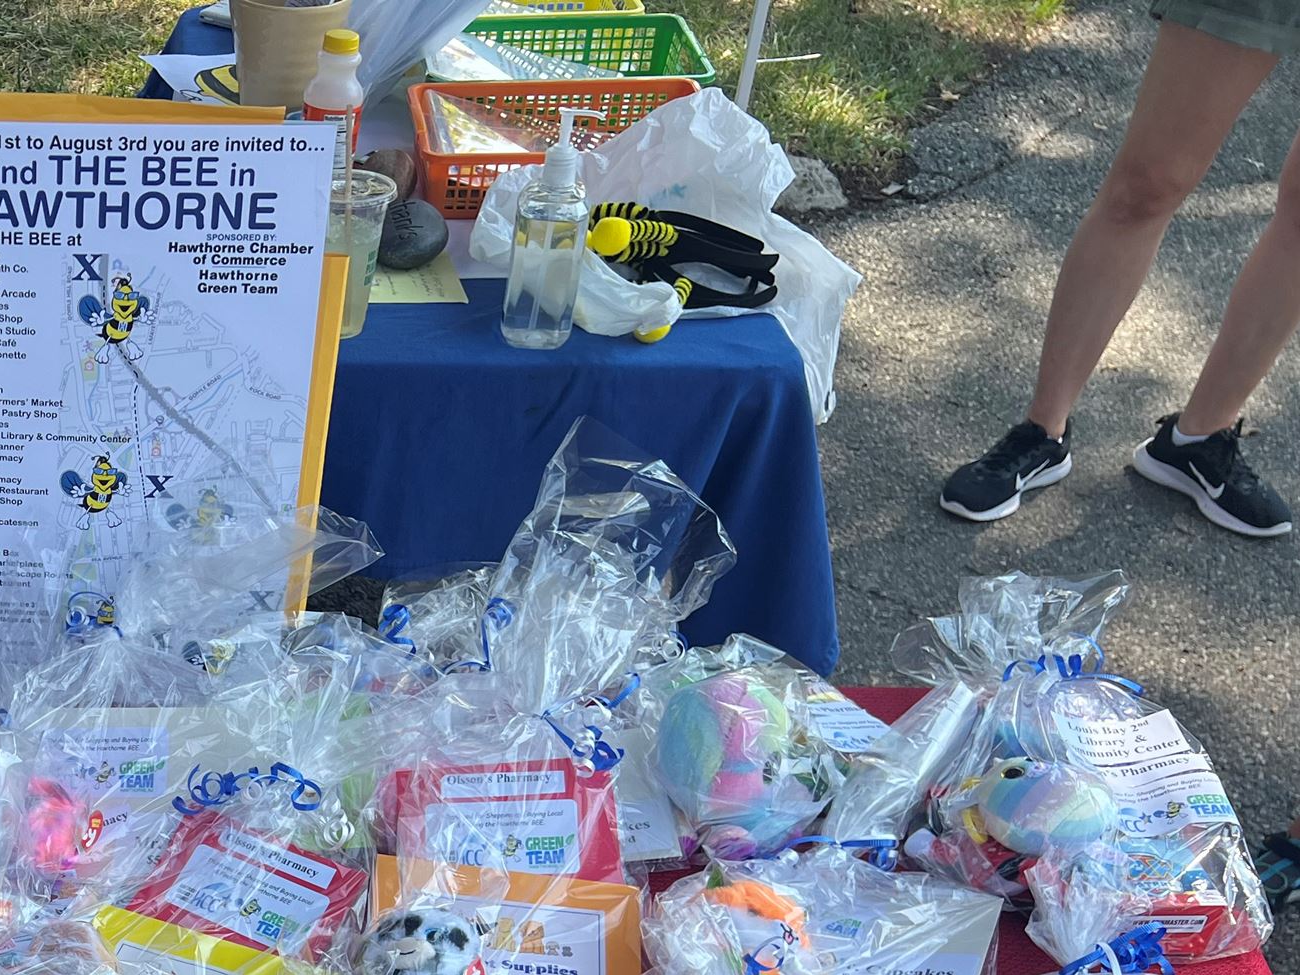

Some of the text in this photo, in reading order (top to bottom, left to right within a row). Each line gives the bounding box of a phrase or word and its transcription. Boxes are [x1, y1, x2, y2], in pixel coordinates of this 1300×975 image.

[27, 136, 43, 150] to
[49, 136, 113, 155] August
[119, 137, 147, 151] 3rd
[154, 139, 185, 155] you
[191, 139, 219, 152] are
[225, 137, 283, 152] invited
[290, 138, 325, 152] to...
[49, 156, 126, 186] THE
[142, 157, 218, 186] BEE
[231, 163, 255, 186] in
[28, 232, 64, 246] BEE
[68, 234, 82, 246] at
[169, 242, 313, 255] Hawthorne Chamber
[193, 255, 286, 266] of Commerce
[13, 265, 28, 273] Co.
[200, 270, 278, 281] Hawthorne
[1, 290, 36, 298] Arcade
[198, 283, 278, 294] Green Team
[5, 327, 36, 335] Studio
[31, 399, 63, 407] Market
[1, 432, 33, 442] Library
[46, 433, 97, 443] Community
[100, 435, 131, 443] Center
[1078, 736, 1126, 746] Library
[1134, 738, 1181, 754] Center
[1121, 756, 1190, 777] Pharmacy
[447, 773, 551, 785] Olsson's Pharmacy
[525, 836, 565, 851] GREEN
[525, 849, 565, 865] TEAM
[269, 849, 319, 878] Pharmacy
